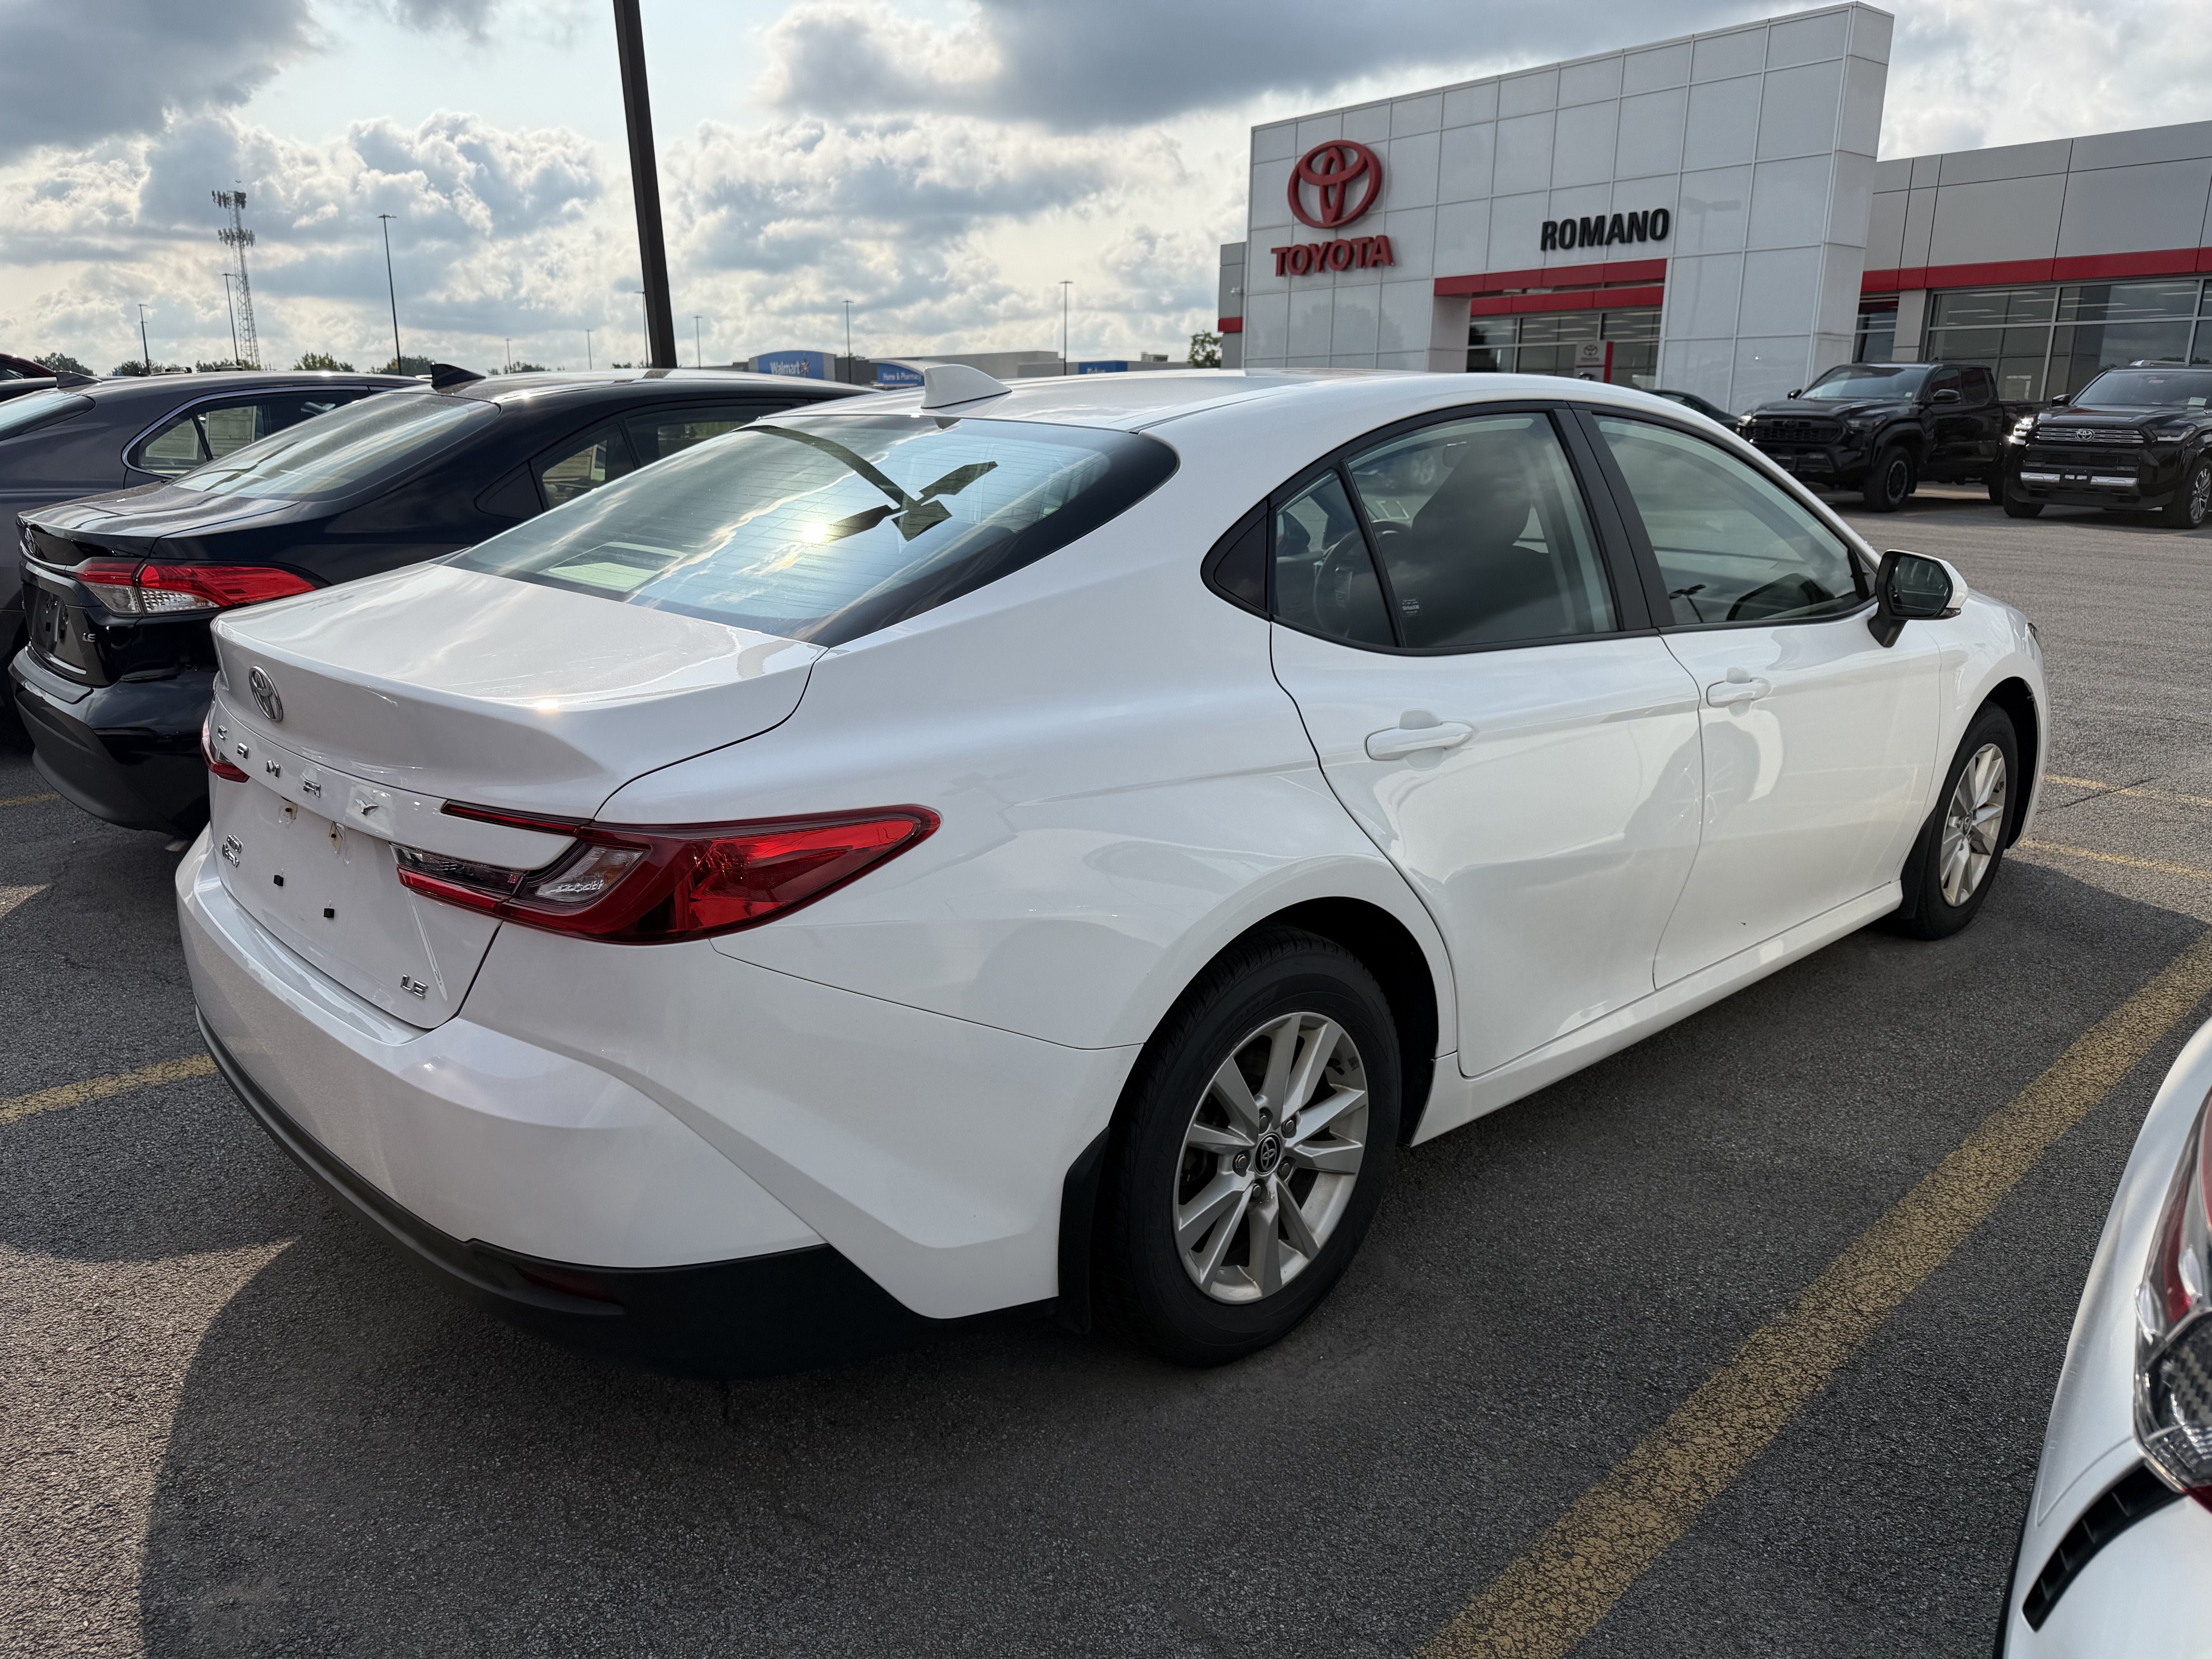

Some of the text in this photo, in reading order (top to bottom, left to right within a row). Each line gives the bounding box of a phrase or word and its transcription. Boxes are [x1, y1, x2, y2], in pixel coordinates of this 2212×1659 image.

[1540, 208, 1669, 251] ROMANO
[1271, 235, 1395, 276] TOYOTA
[770, 361, 800, 375] Walmart
[883, 372, 921, 382] Home & Pharmacy
[218, 725, 379, 816] CAMRY
[400, 974, 428, 999] LE
